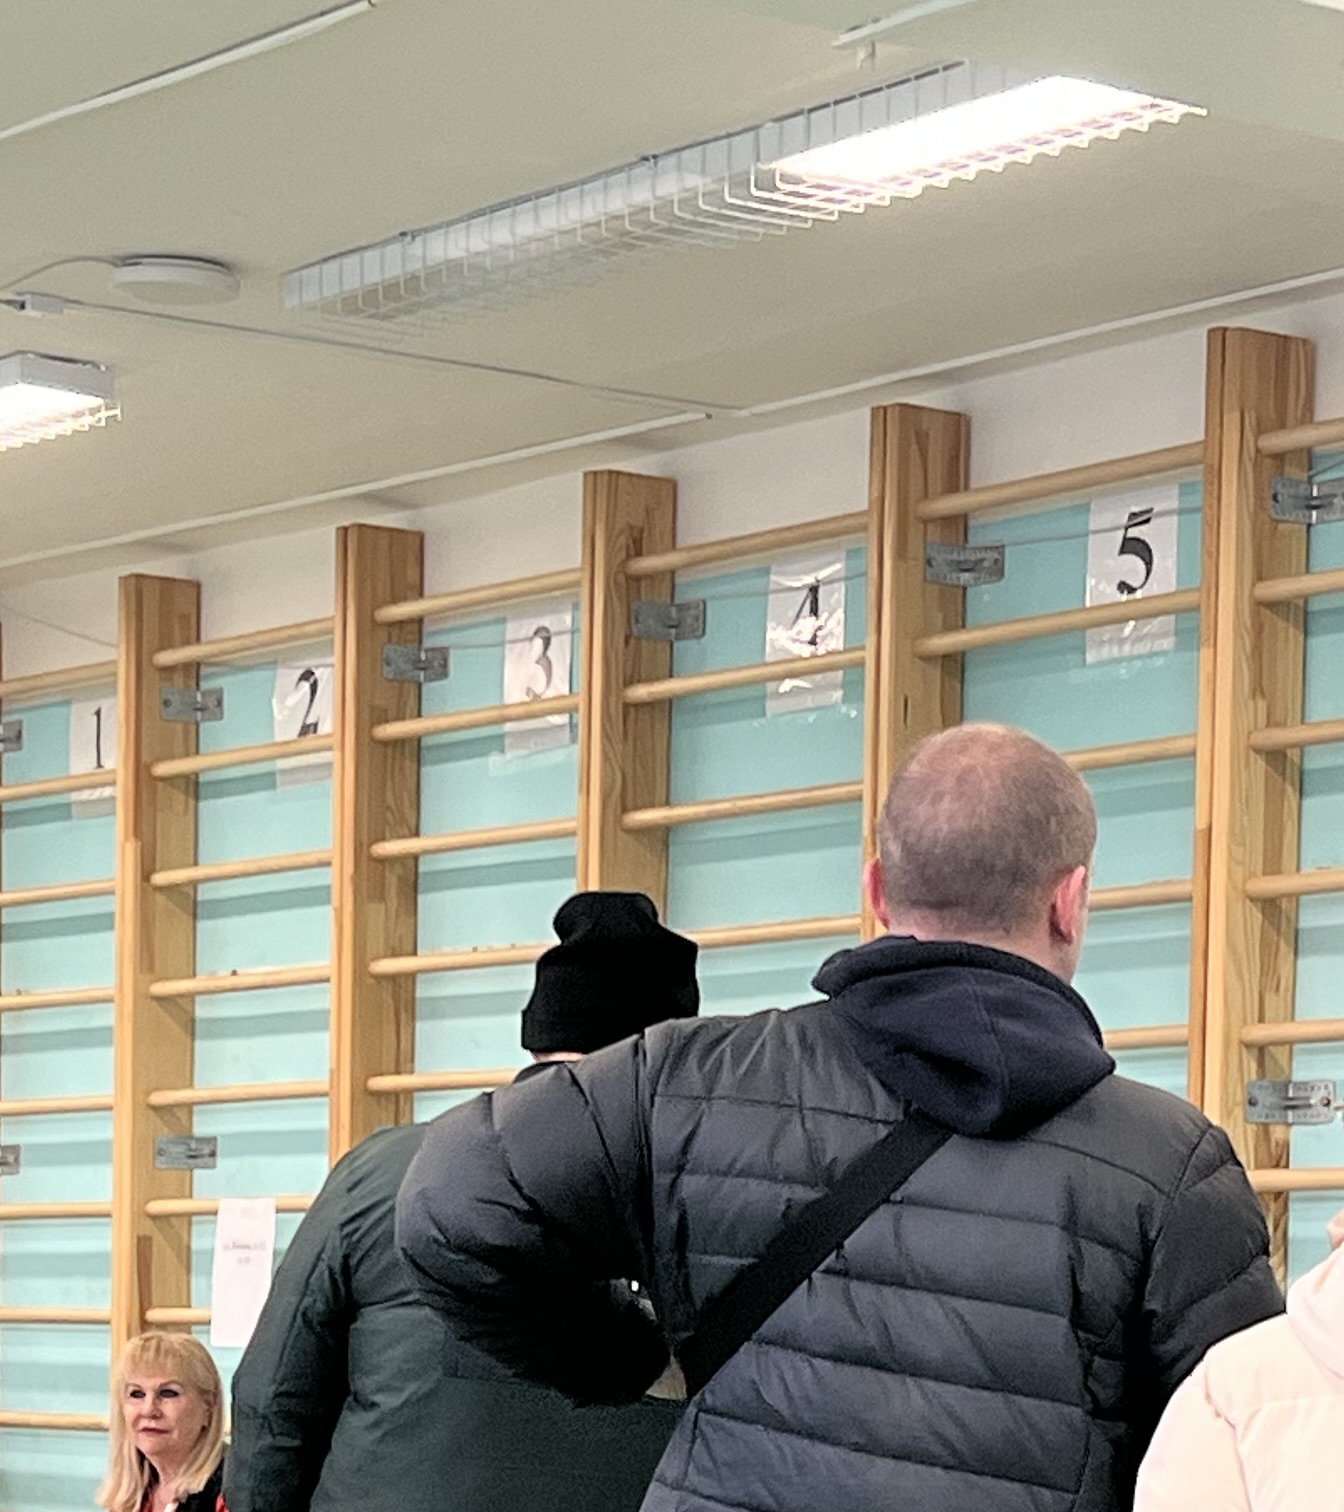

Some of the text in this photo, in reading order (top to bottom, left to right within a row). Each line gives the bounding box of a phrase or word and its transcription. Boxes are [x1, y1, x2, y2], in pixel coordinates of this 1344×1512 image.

[1116, 507, 1155, 595] 5
[525, 625, 553, 702] 3
[92, 705, 105, 770] 1
[295, 666, 319, 739] 2
